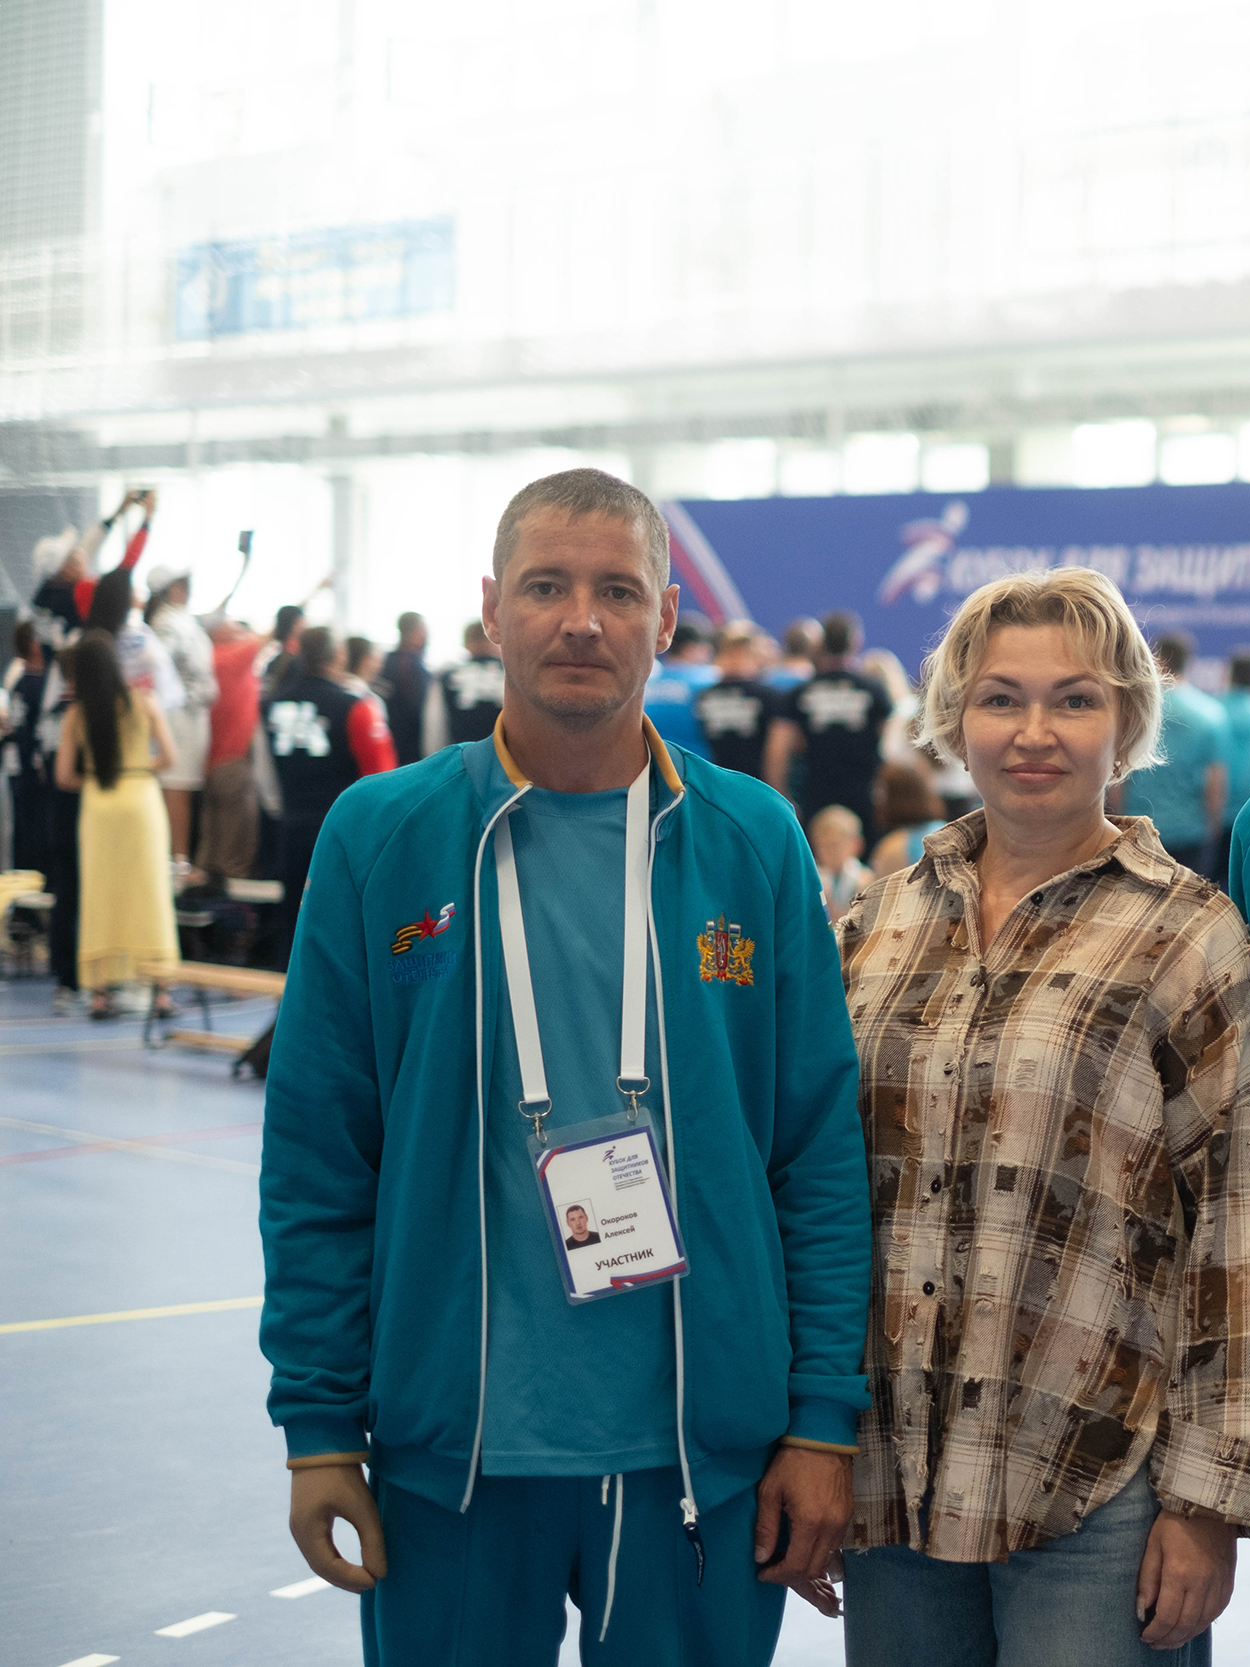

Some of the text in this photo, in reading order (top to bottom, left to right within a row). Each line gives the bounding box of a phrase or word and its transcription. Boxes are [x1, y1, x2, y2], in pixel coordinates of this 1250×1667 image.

[611, 1159, 649, 1173] ЗАЩИТНИКОВ
[613, 1169, 643, 1180] ОТЕЧЕСТВА
[600, 1212, 638, 1226] Окороков
[604, 1225, 636, 1239] Алексей
[595, 1248, 655, 1270] УЧАСТНИК
